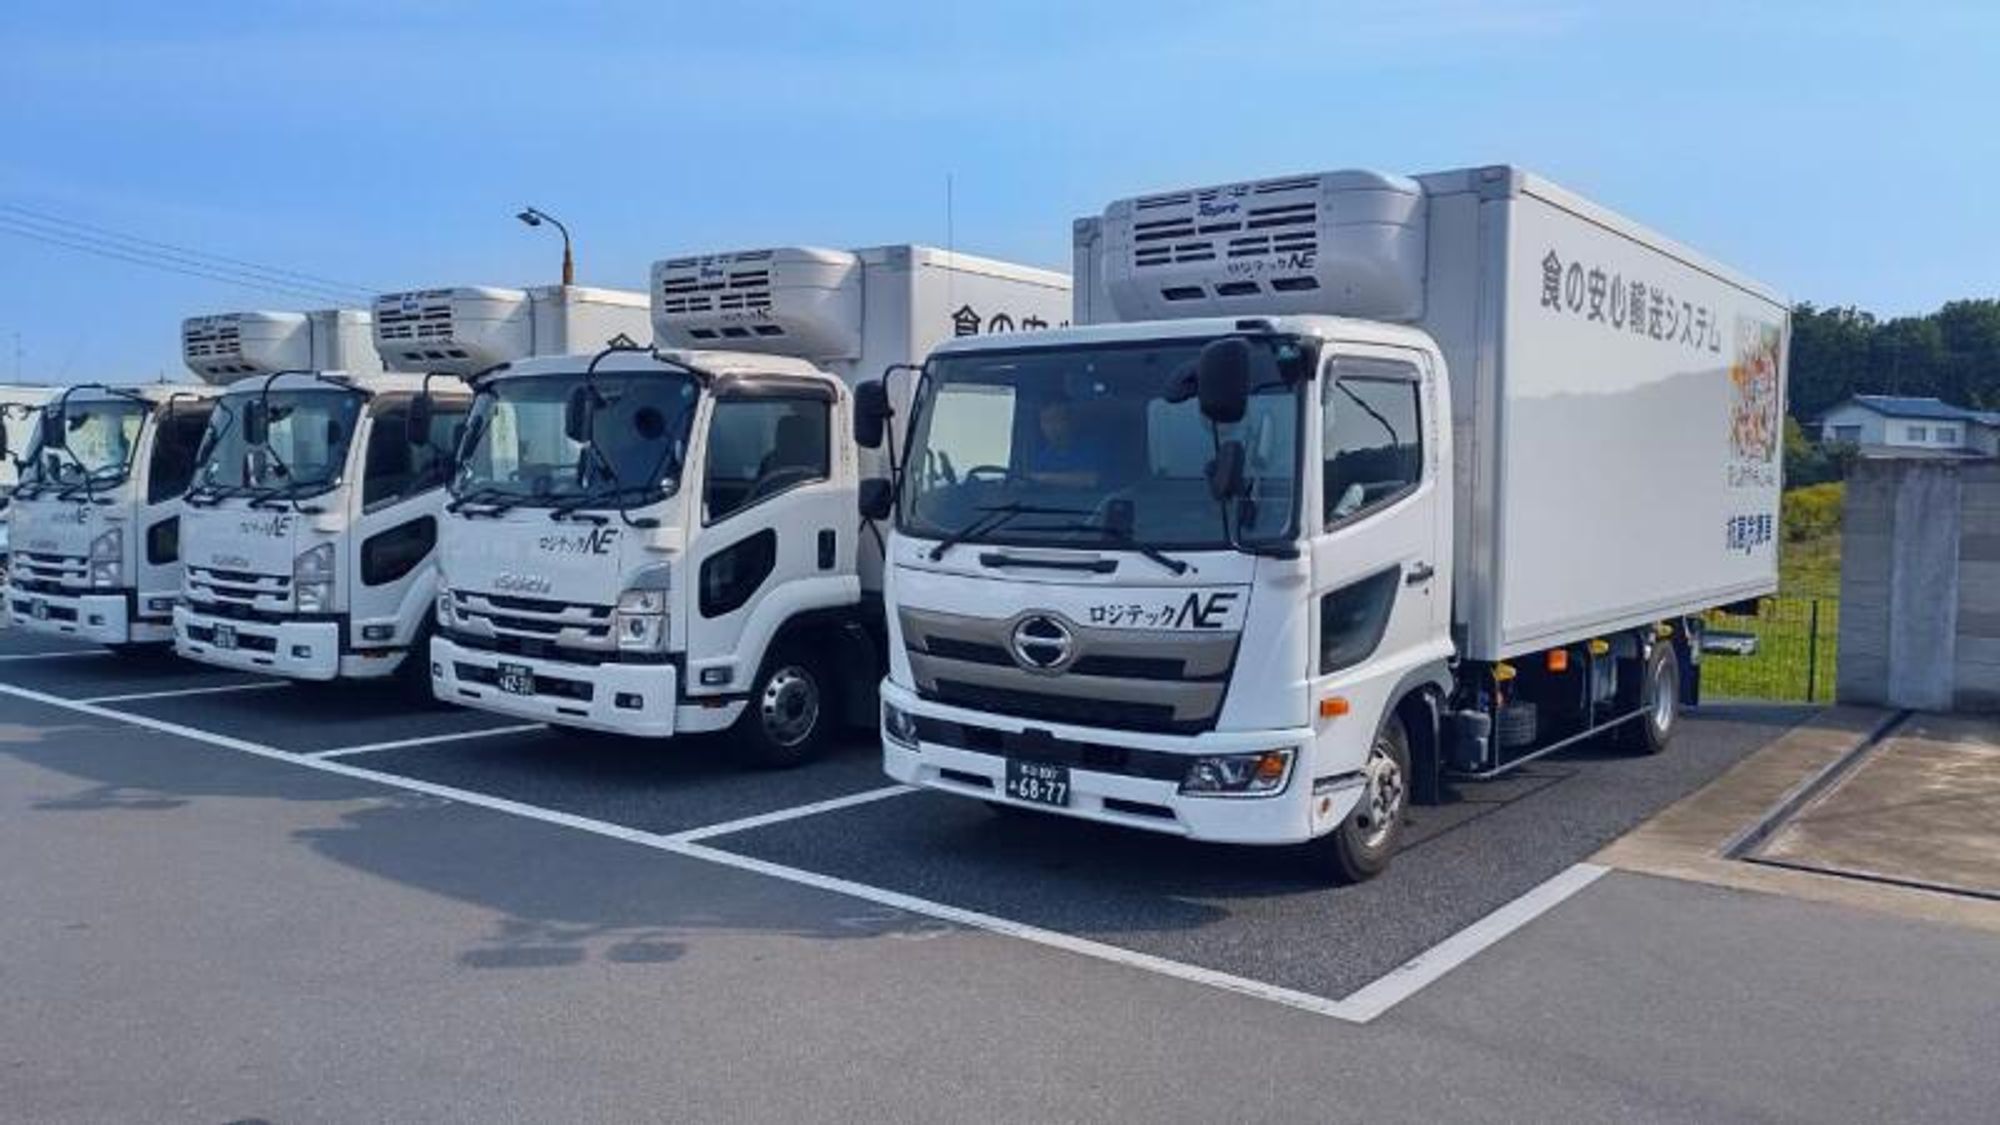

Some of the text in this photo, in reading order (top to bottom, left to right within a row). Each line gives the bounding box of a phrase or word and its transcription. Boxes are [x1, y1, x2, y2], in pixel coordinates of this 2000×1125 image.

[1541, 249, 1721, 353] 食の安心輸送システム
[951, 303, 1070, 338] 食の
[1090, 592, 1239, 628] ロジテックNE
